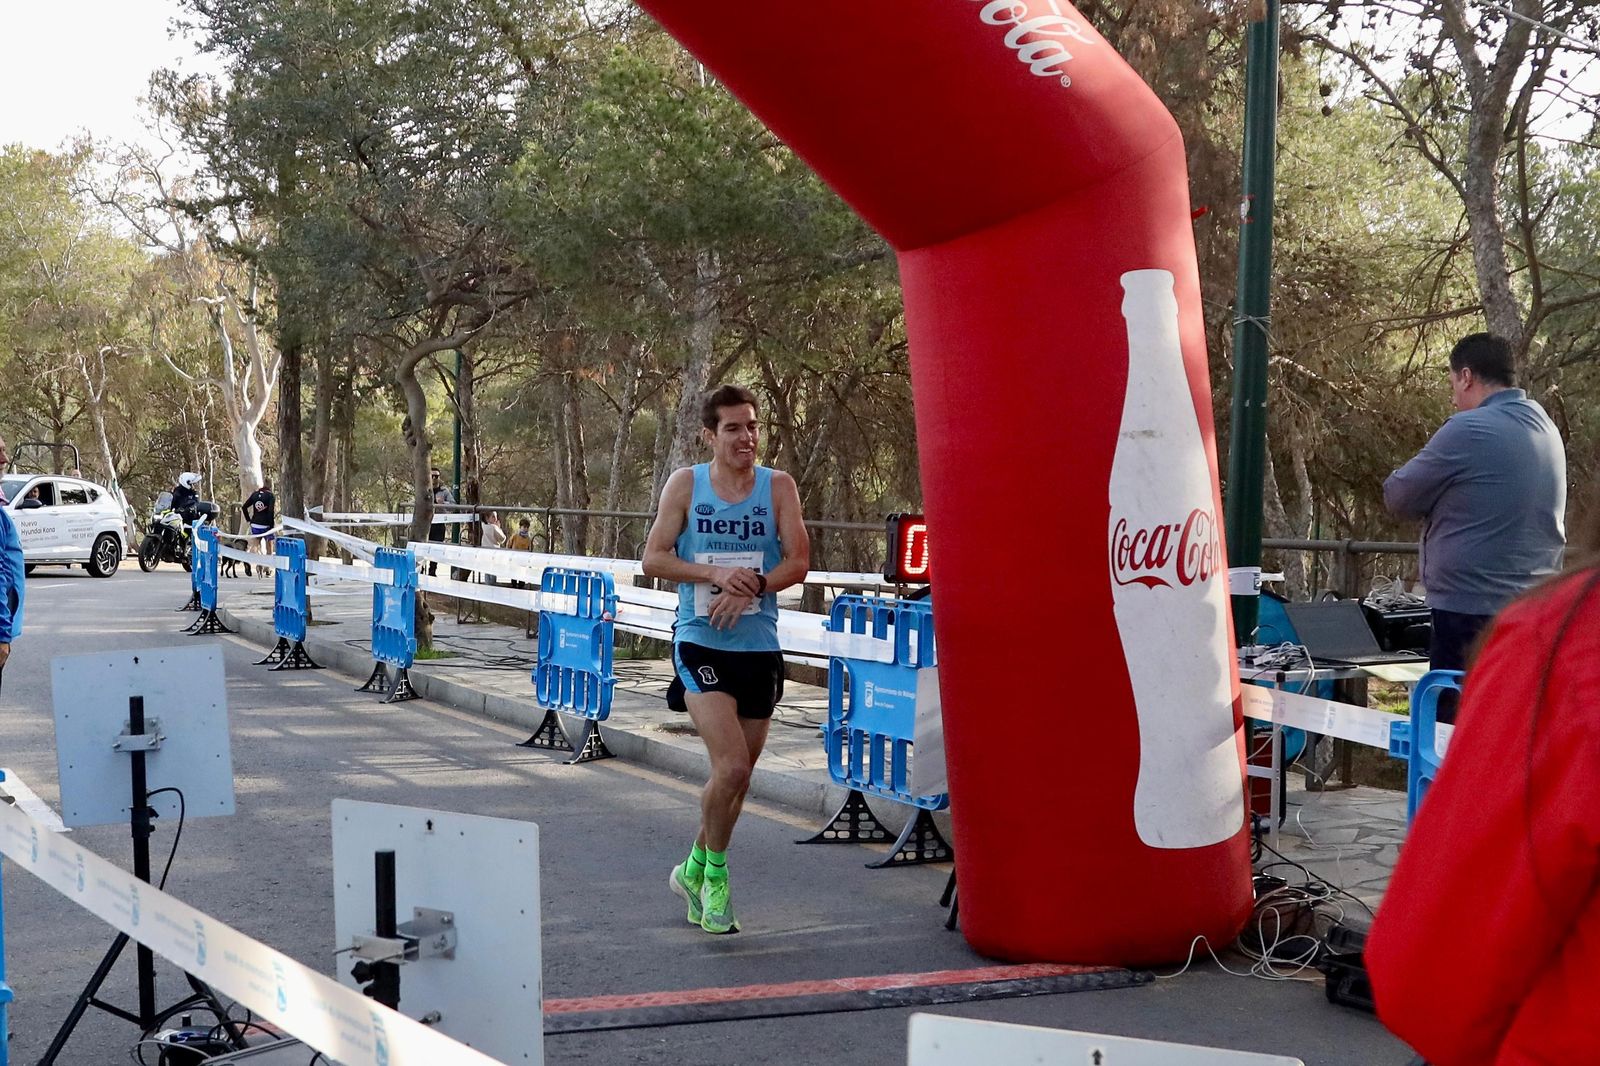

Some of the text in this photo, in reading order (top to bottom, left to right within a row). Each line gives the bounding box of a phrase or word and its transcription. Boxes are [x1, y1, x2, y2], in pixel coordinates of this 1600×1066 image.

[979, 0, 1095, 76] ola
[21, 527, 41, 536] Hyundai
[697, 515, 766, 541] nerja
[707, 542, 757, 552] ATLETISMO
[1111, 508, 1220, 590] Coca-Cola
